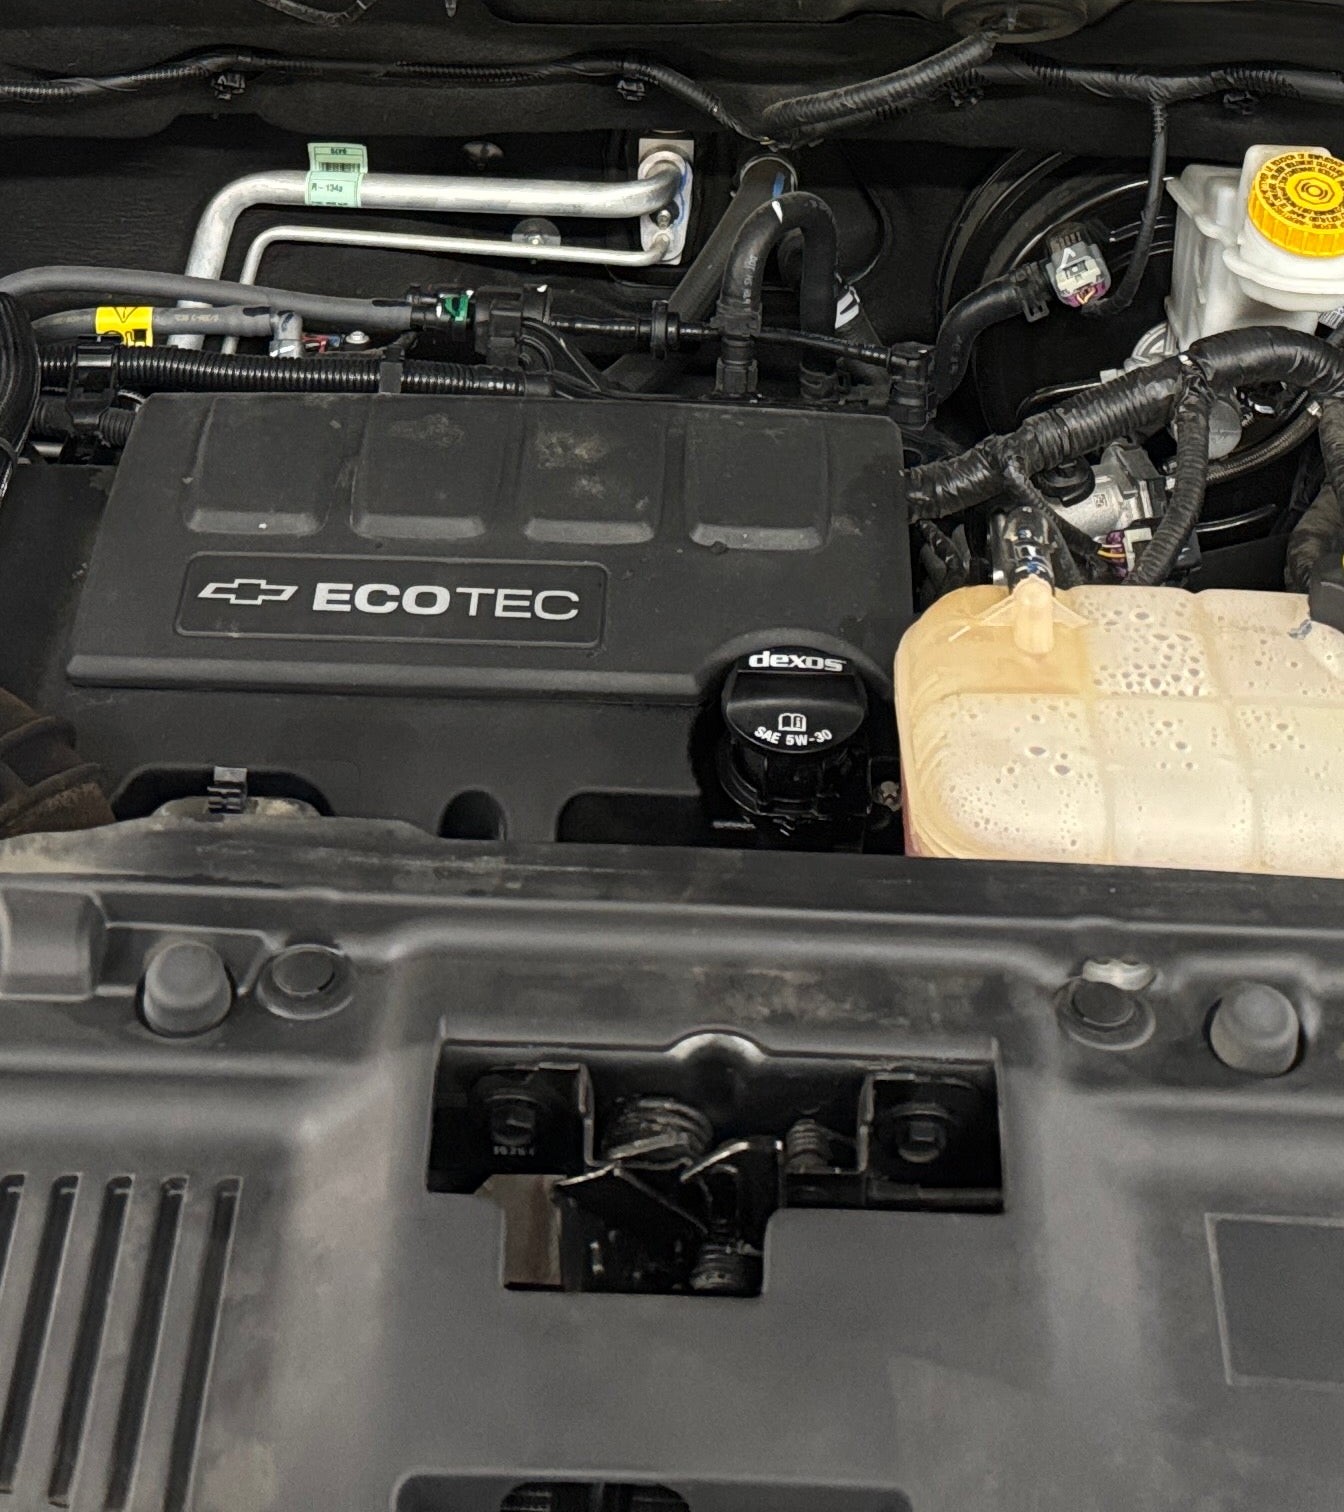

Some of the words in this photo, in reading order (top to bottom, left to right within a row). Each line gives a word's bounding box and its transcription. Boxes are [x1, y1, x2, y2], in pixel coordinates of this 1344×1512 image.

[312, 582, 580, 620] ECOTEC
[748, 650, 846, 672] dexos
[754, 726, 781, 744] SAE
[785, 729, 833, 746] 5W-30
